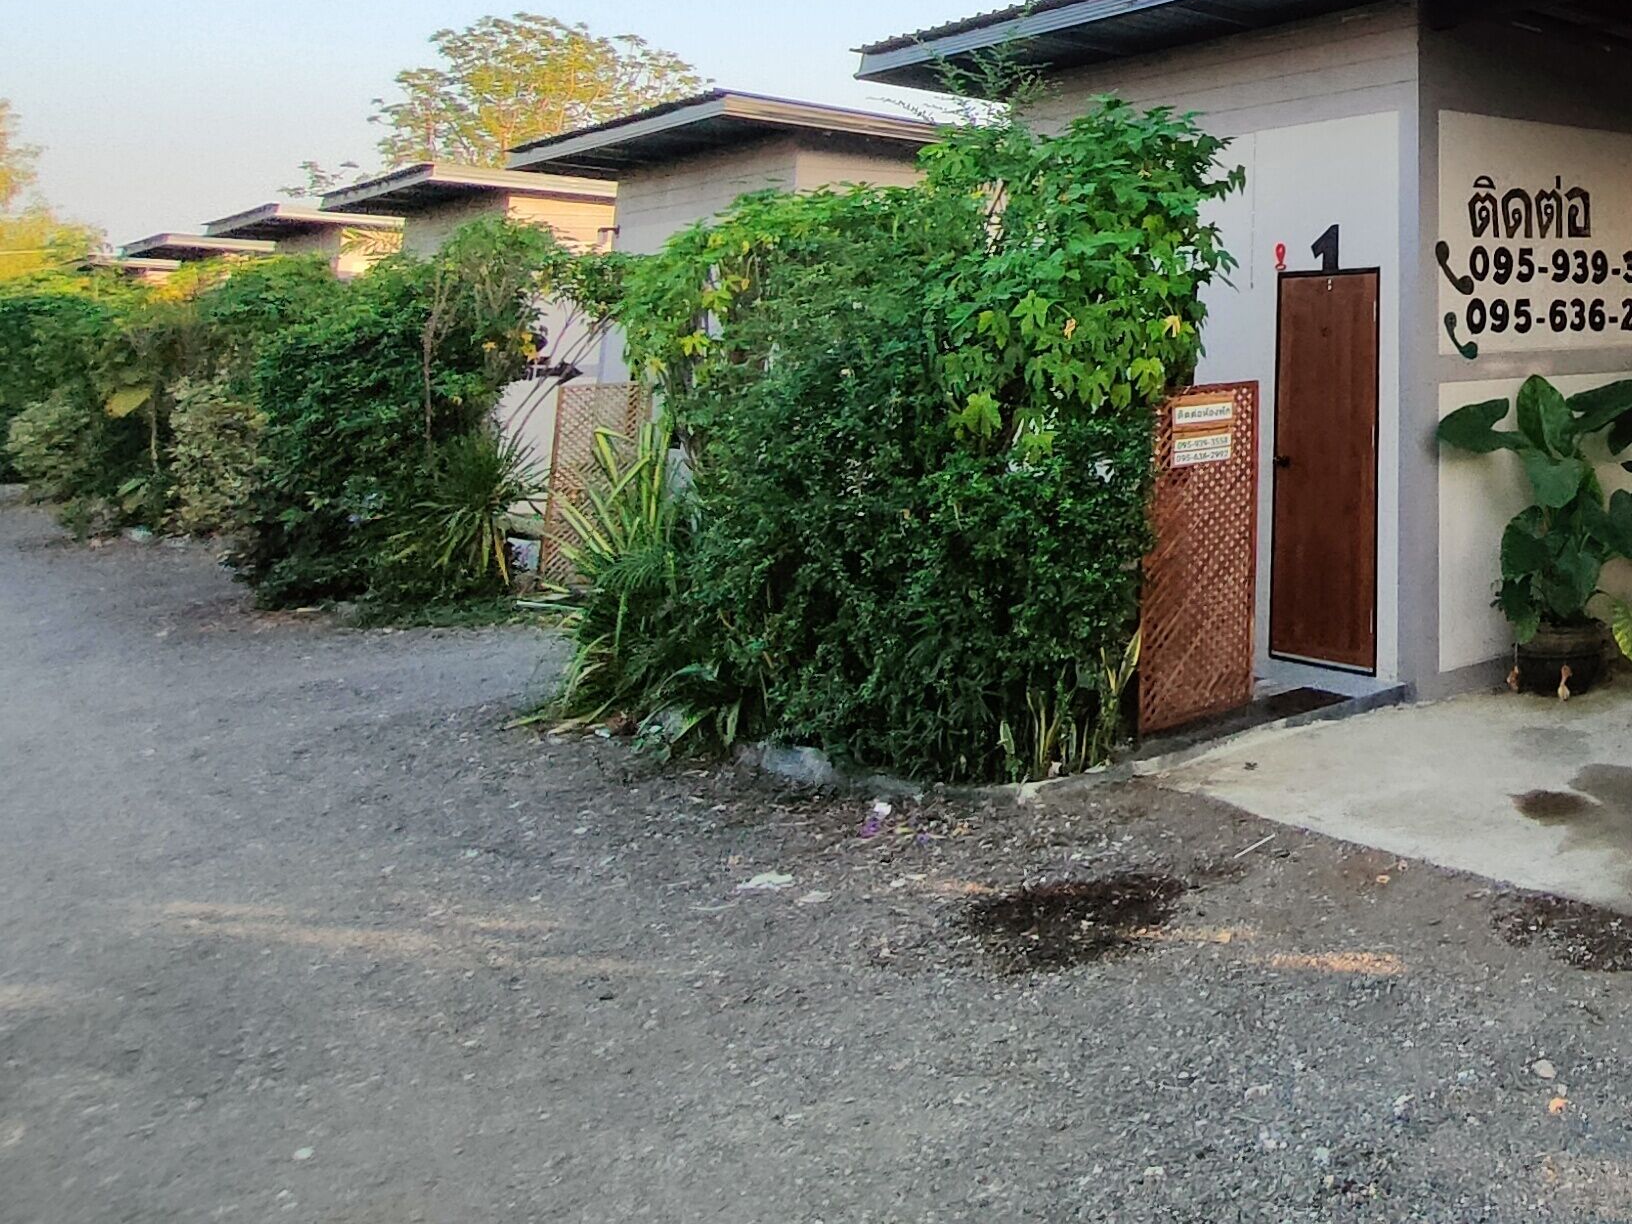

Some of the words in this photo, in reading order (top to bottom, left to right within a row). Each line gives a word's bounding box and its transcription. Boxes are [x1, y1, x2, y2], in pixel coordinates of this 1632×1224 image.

[1467, 175, 1591, 239] ติดต่อ
[1310, 223, 1340, 272] 1
